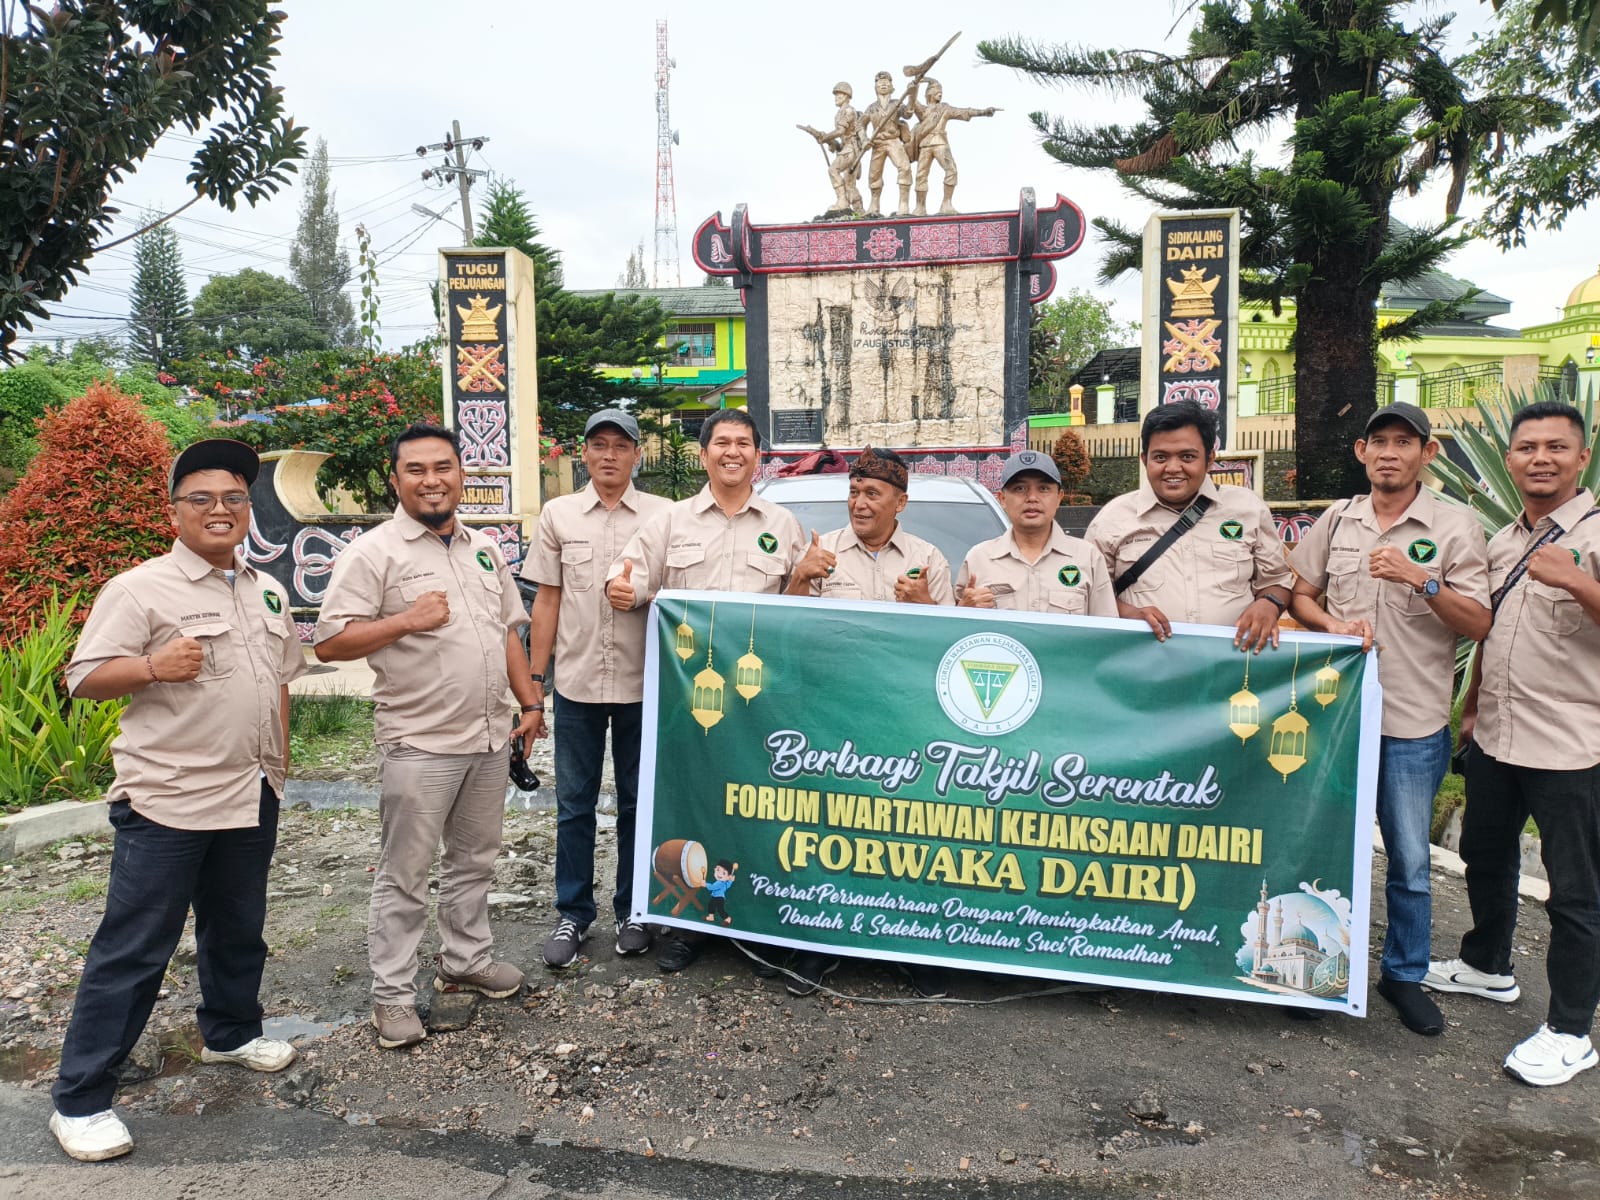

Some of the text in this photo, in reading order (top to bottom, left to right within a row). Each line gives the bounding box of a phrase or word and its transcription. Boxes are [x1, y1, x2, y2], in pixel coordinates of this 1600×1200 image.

[1166, 245, 1224, 261] DAIRI
[1167, 230, 1223, 245] SIDIKALANG
[449, 277, 505, 290] PERJUANGAN
[456, 263, 499, 275] TUGU
[862, 339, 910, 348] AUGUSTUS
[941, 659, 952, 685] FORUM
[951, 637, 990, 659] WARTAWAN
[993, 638, 1029, 666] KEJAKSAAN
[962, 718, 1012, 731] DAIRI
[766, 730, 1223, 806] Berbagi Takjil Serentak
[725, 783, 1263, 864] FORUM WARTAWAN KEJAKSAAN DAIRI
[778, 826, 1196, 911] (FORWAKA DAIRI)
[750, 874, 1221, 947] "Pererat Persaudaraan Dengan Meningkatkan Amal,
[778, 904, 1182, 966] Ibadah & Sedekah Dibulan Suci Ramadhan"
